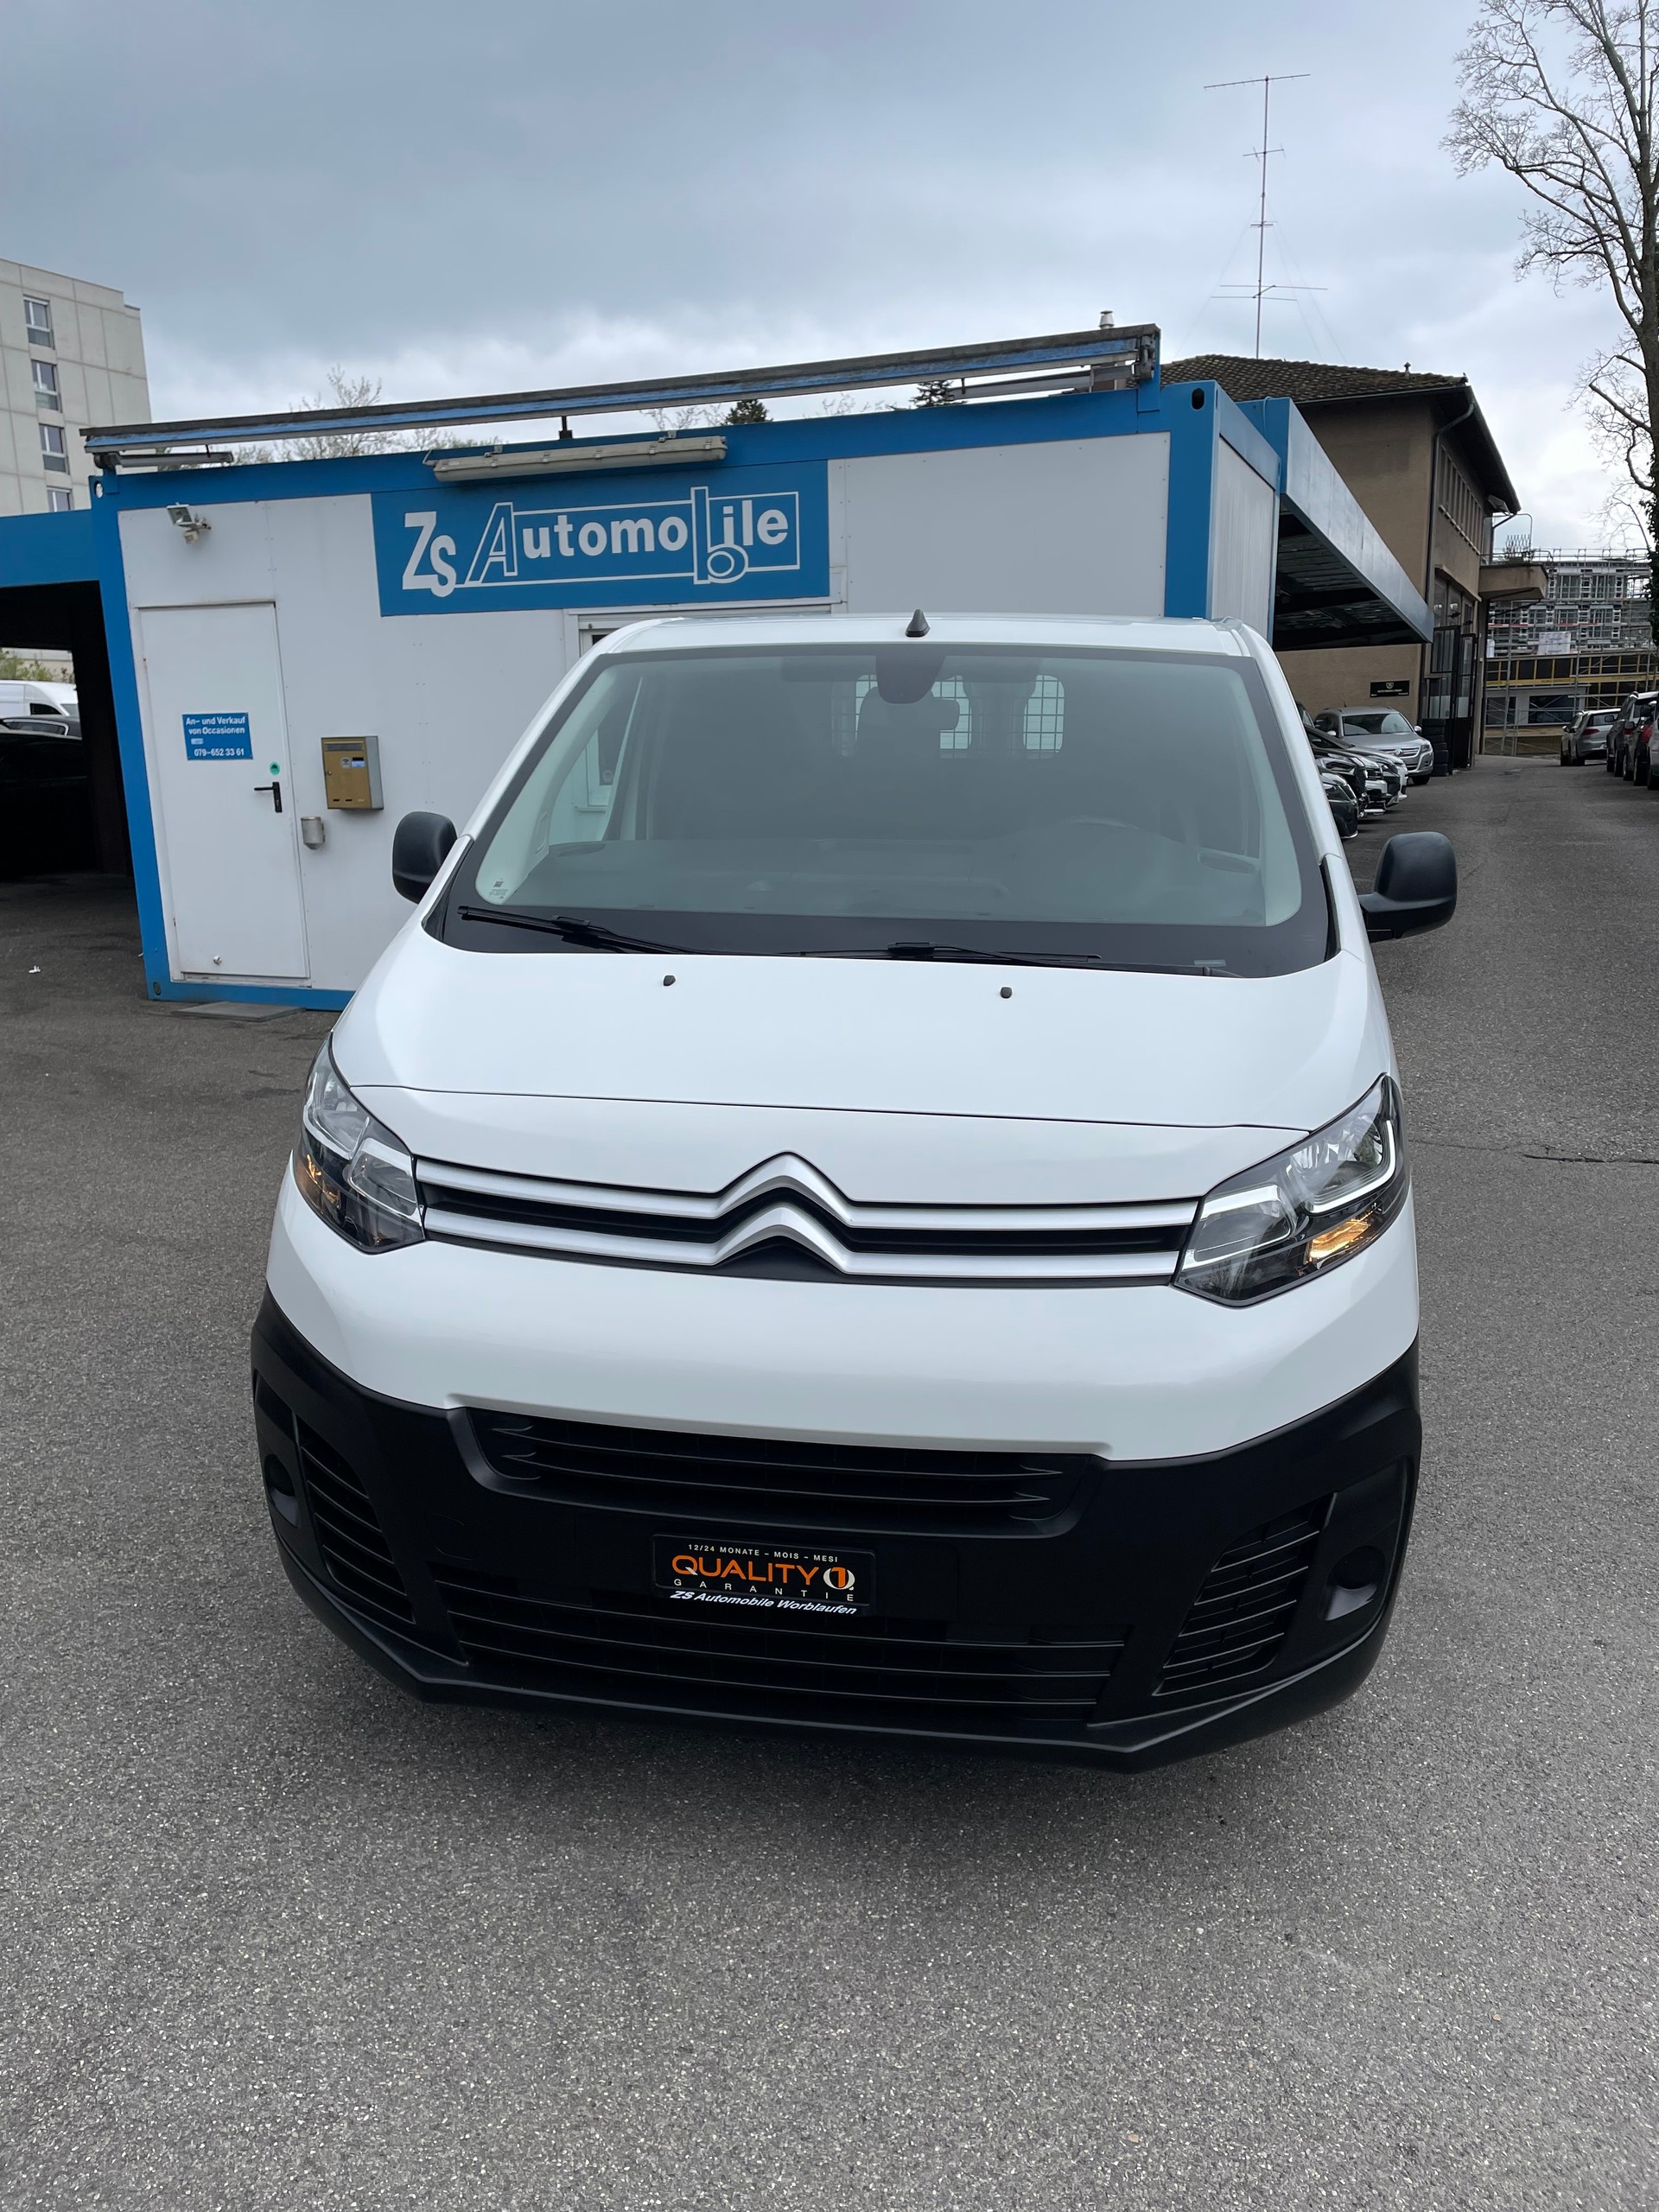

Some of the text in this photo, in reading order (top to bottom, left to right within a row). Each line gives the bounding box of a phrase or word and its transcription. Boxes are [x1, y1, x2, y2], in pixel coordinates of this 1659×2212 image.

[464, 486, 789, 584] Automobile
[202, 726, 245, 734] Occasionen
[720, 1547, 760, 1555] MONATE
[774, 1551, 799, 1560] MOIS
[813, 1554, 838, 1563] MESI
[672, 1554, 819, 1586] QUALITY
[674, 1579, 854, 1601] GARANTIE
[670, 1591, 857, 1614] ZS Automobile Worblaufen
